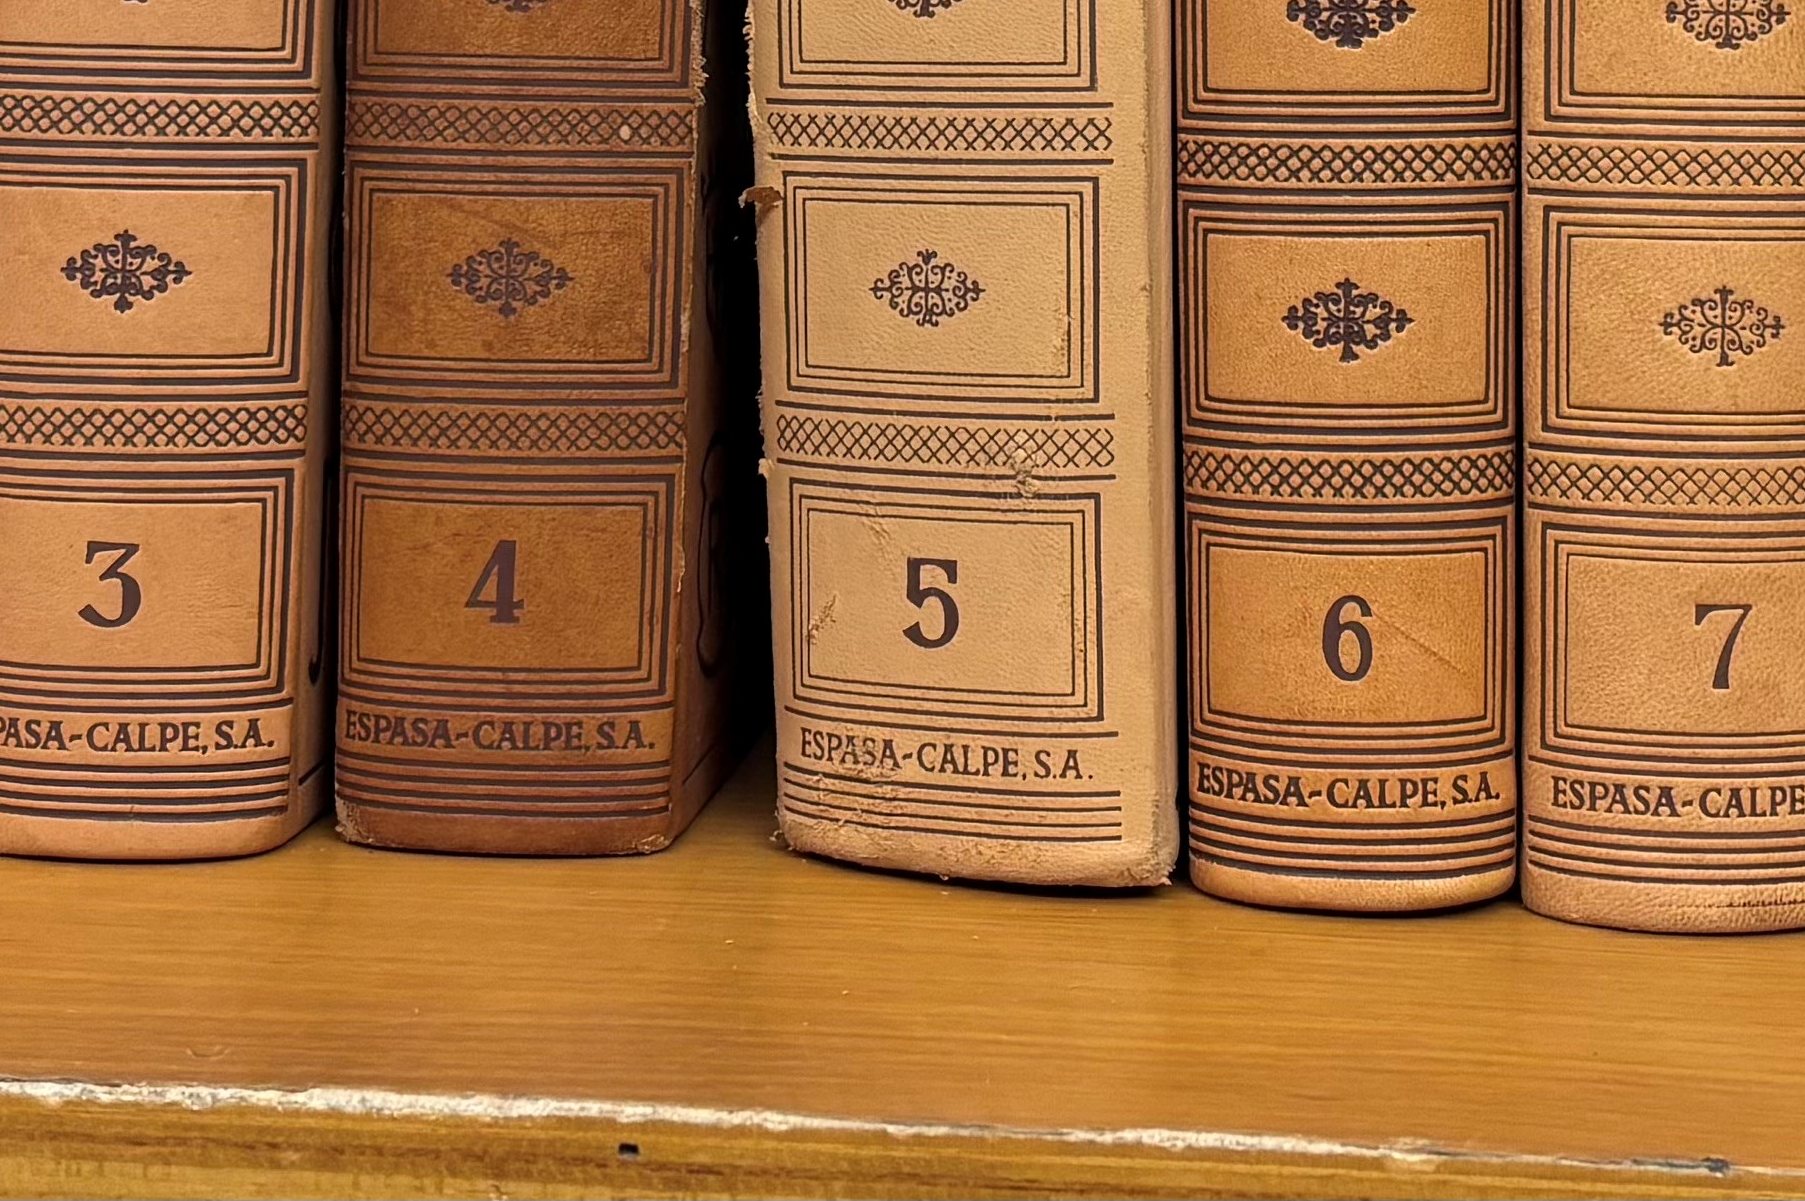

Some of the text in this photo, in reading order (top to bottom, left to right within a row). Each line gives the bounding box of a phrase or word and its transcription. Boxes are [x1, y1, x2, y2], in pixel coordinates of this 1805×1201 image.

[77, 540, 142, 628] 3
[464, 539, 525, 624] 4
[902, 557, 959, 649] 5
[1322, 595, 1374, 683] 6
[1695, 603, 1752, 690] 7
